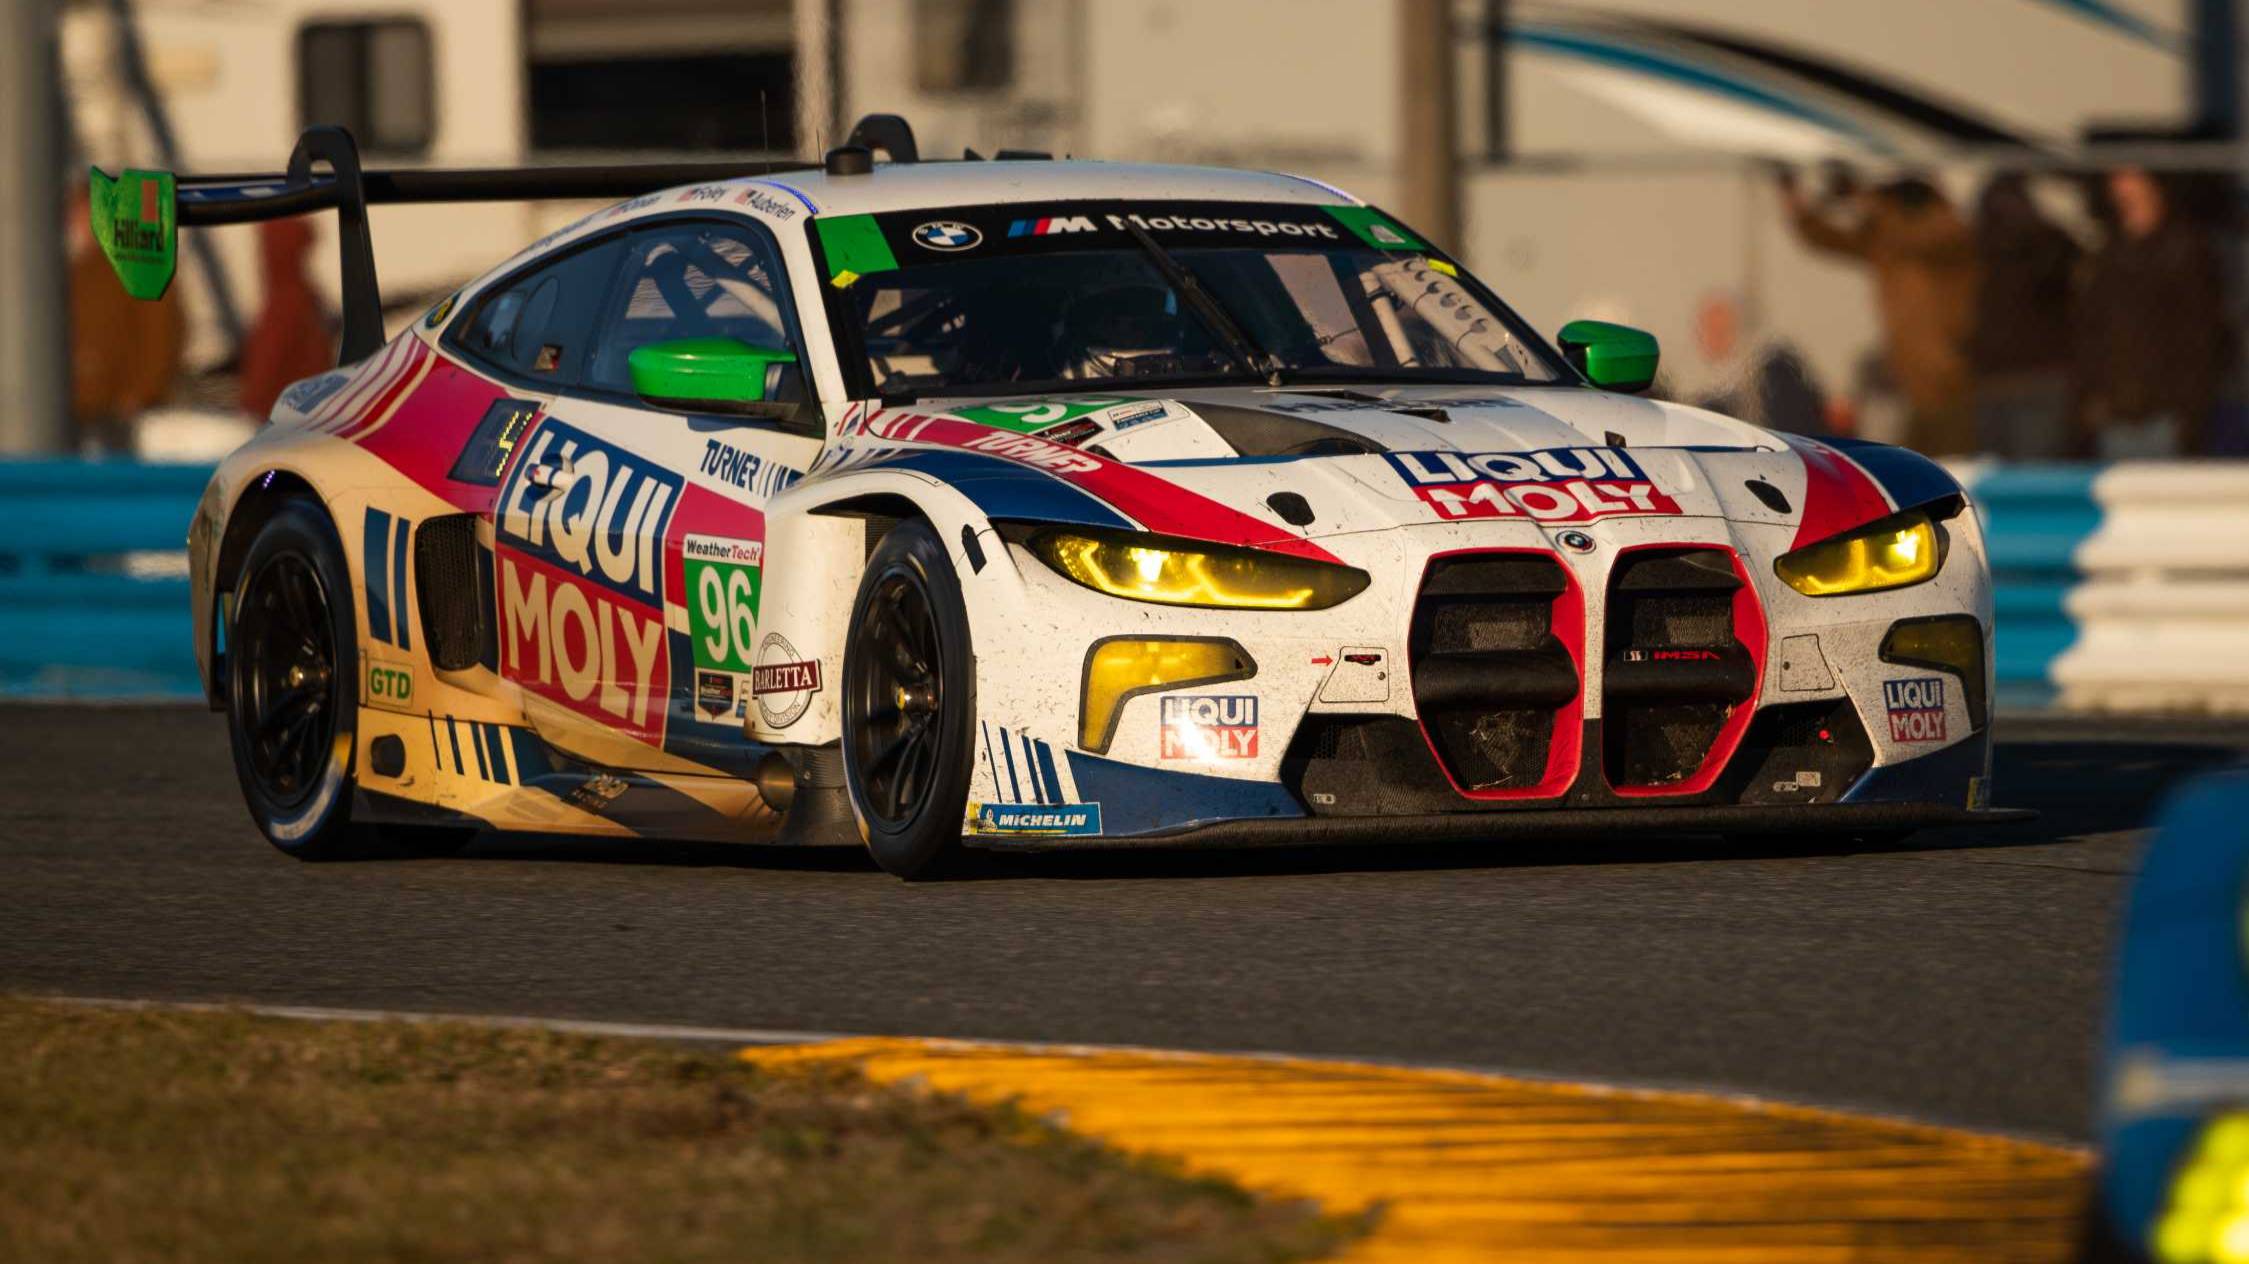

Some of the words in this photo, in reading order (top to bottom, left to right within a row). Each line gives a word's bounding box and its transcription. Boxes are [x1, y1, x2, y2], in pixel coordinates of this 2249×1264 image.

[1105, 213, 1338, 240] Motorsport
[700, 438, 761, 492] TURNER
[961, 431, 1103, 473] TURNER
[1395, 448, 1636, 484] LIQUI
[504, 430, 673, 594] LIQUI
[1427, 481, 1657, 519] MOLY
[699, 565, 758, 666] 96
[502, 557, 663, 728] MOLY
[371, 667, 411, 699] GTD
[755, 665, 813, 691] BARLETTA
[1885, 681, 1941, 709] LIQUI
[1165, 698, 1254, 726] LIQUI
[1890, 710, 1944, 740] MOLY
[999, 813, 1087, 827] MICHELIN
